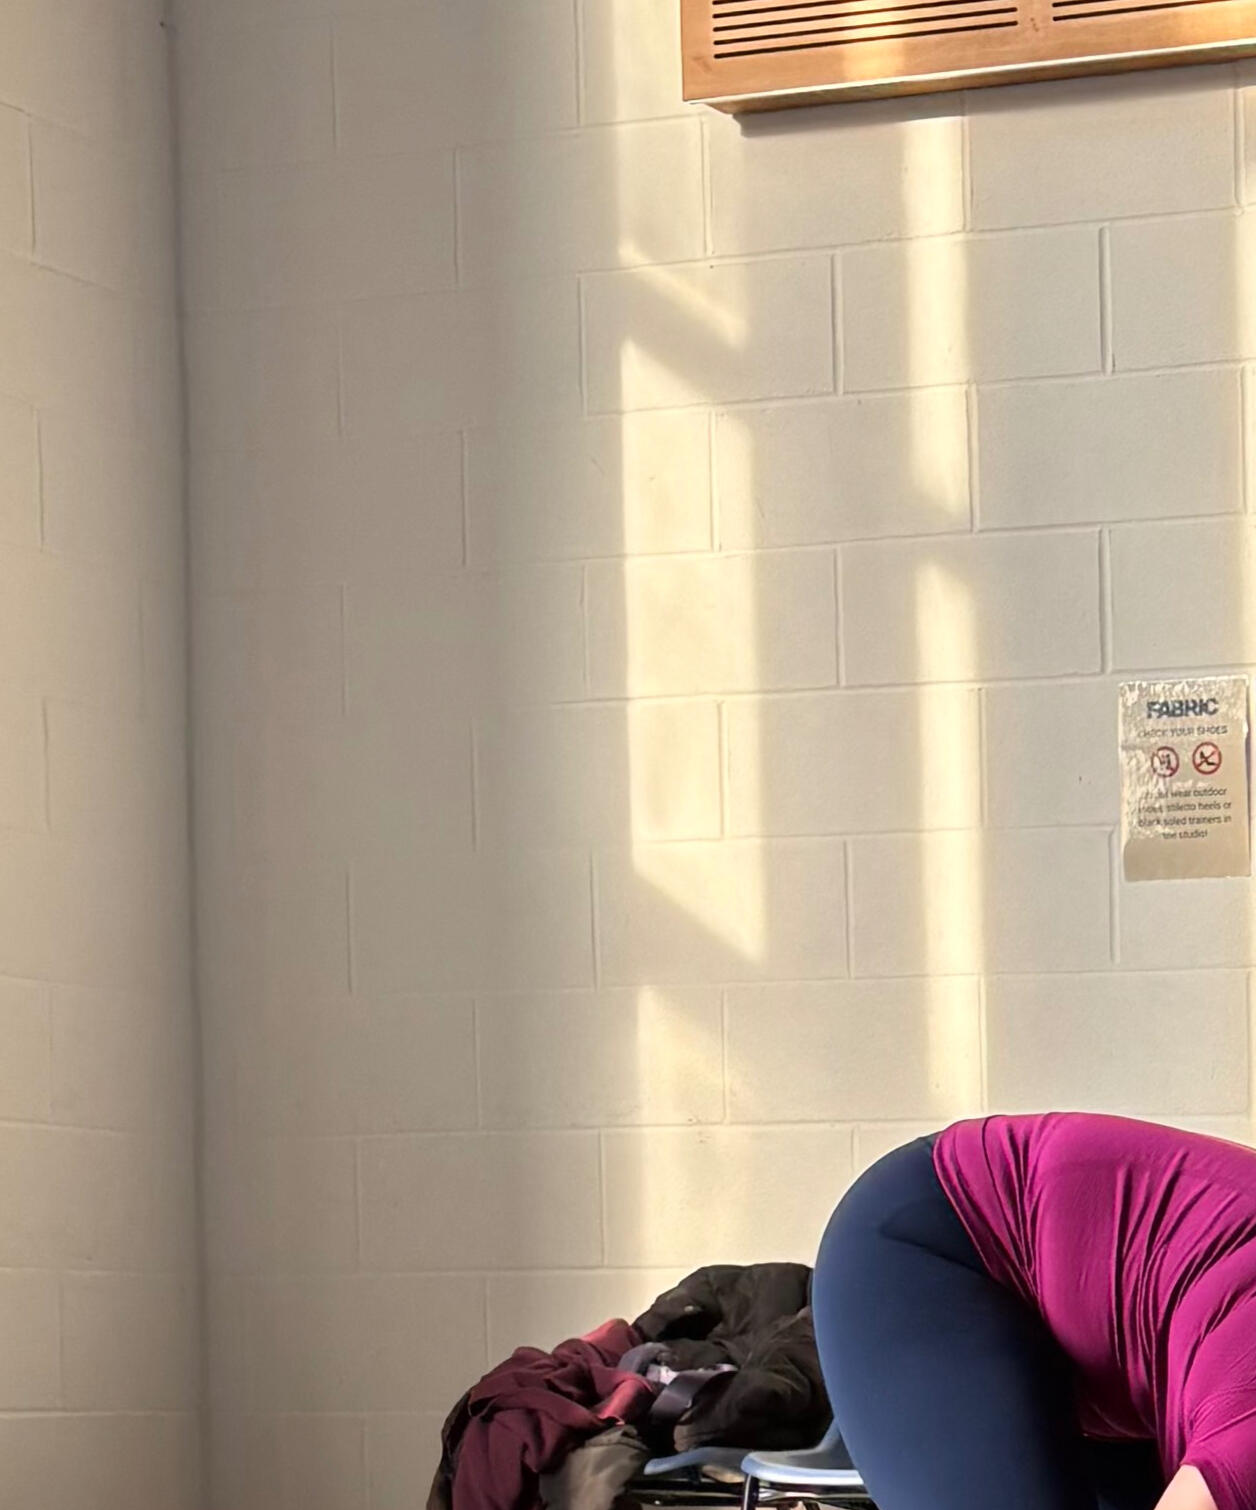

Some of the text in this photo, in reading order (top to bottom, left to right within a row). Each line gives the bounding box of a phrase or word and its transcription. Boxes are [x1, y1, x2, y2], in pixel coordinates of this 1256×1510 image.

[1147, 698, 1219, 719] FABRIC
[1193, 787, 1228, 797] outdoor
[1198, 801, 1222, 811] heels
[1223, 801, 1232, 810] or
[1163, 816, 1187, 826] soled
[1188, 815, 1222, 825] trainers
[1223, 814, 1232, 823] in
